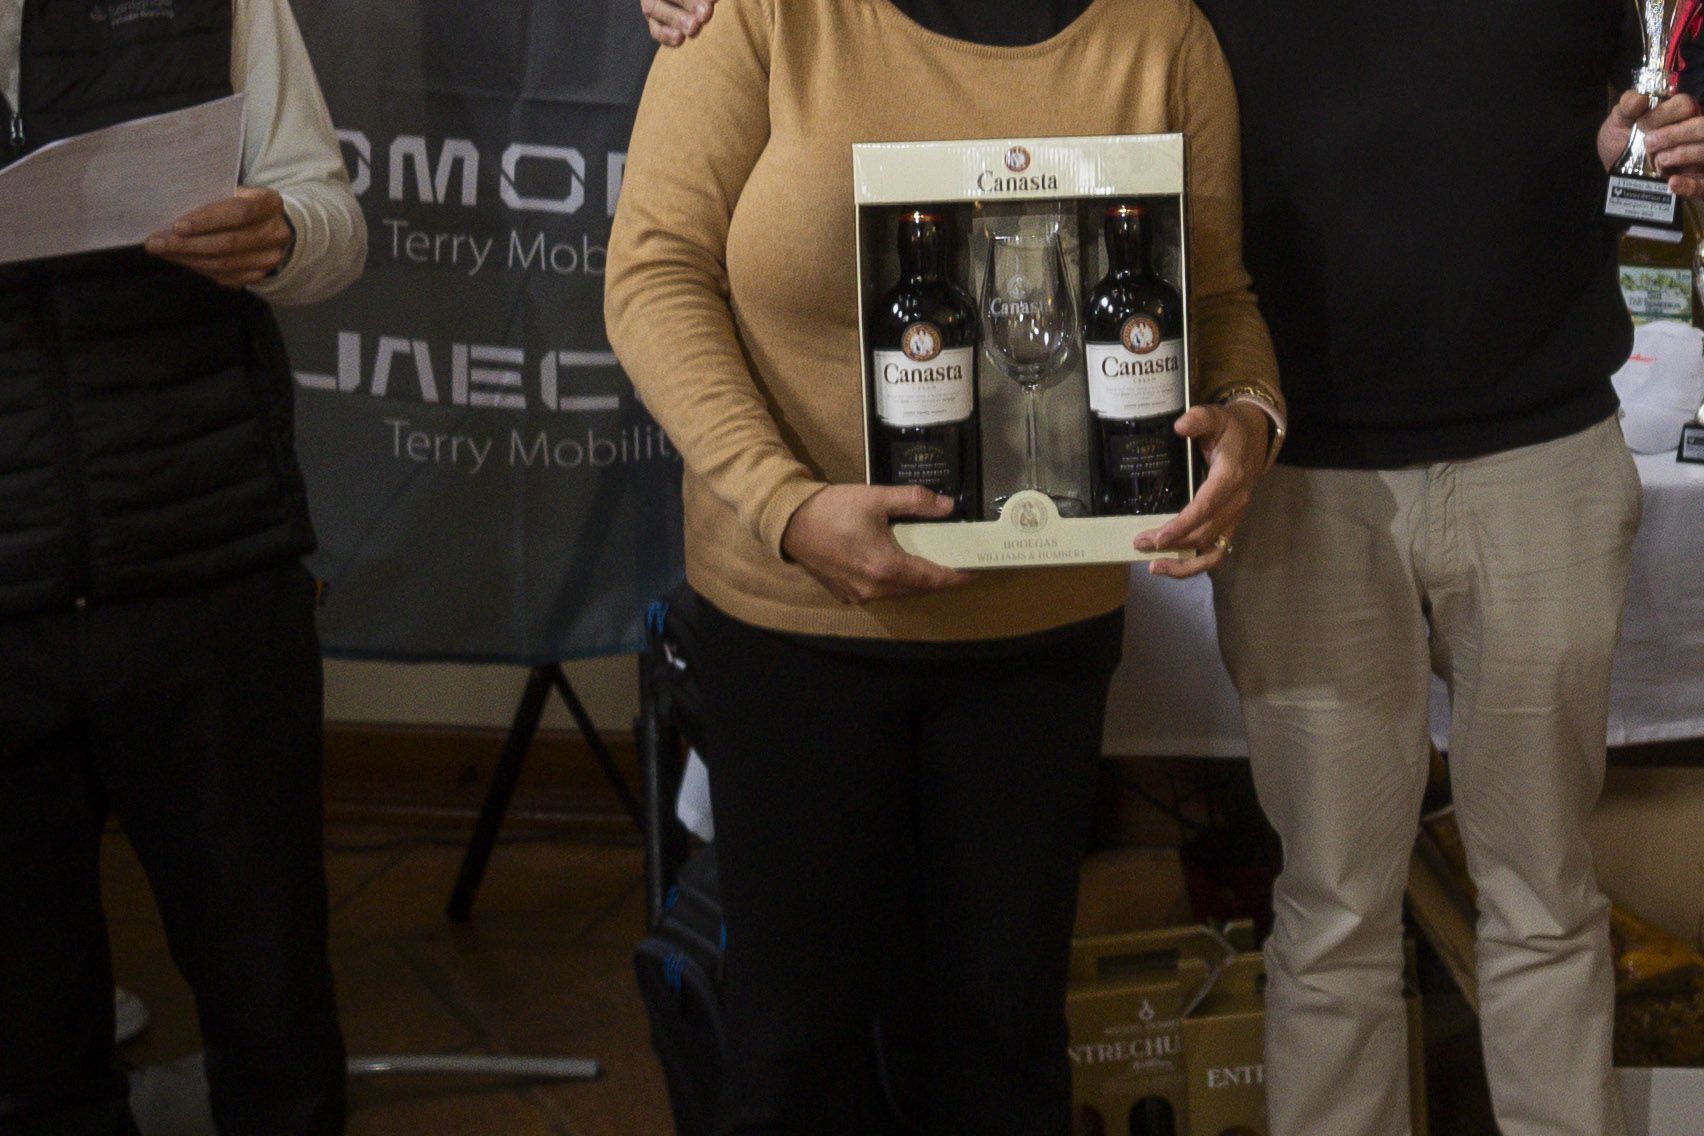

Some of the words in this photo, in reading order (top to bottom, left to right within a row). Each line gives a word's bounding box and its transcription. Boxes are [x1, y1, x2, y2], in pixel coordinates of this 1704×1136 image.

[977, 170, 1058, 193] Canasta
[382, 217, 493, 277] Terry
[293, 331, 621, 413] JAEC
[883, 363, 963, 385] Canasta
[1101, 354, 1179, 378] Canasta
[384, 418, 493, 475] Terry
[508, 426, 683, 470] Mobilit
[1068, 1035, 1184, 1064] NTRECHU
